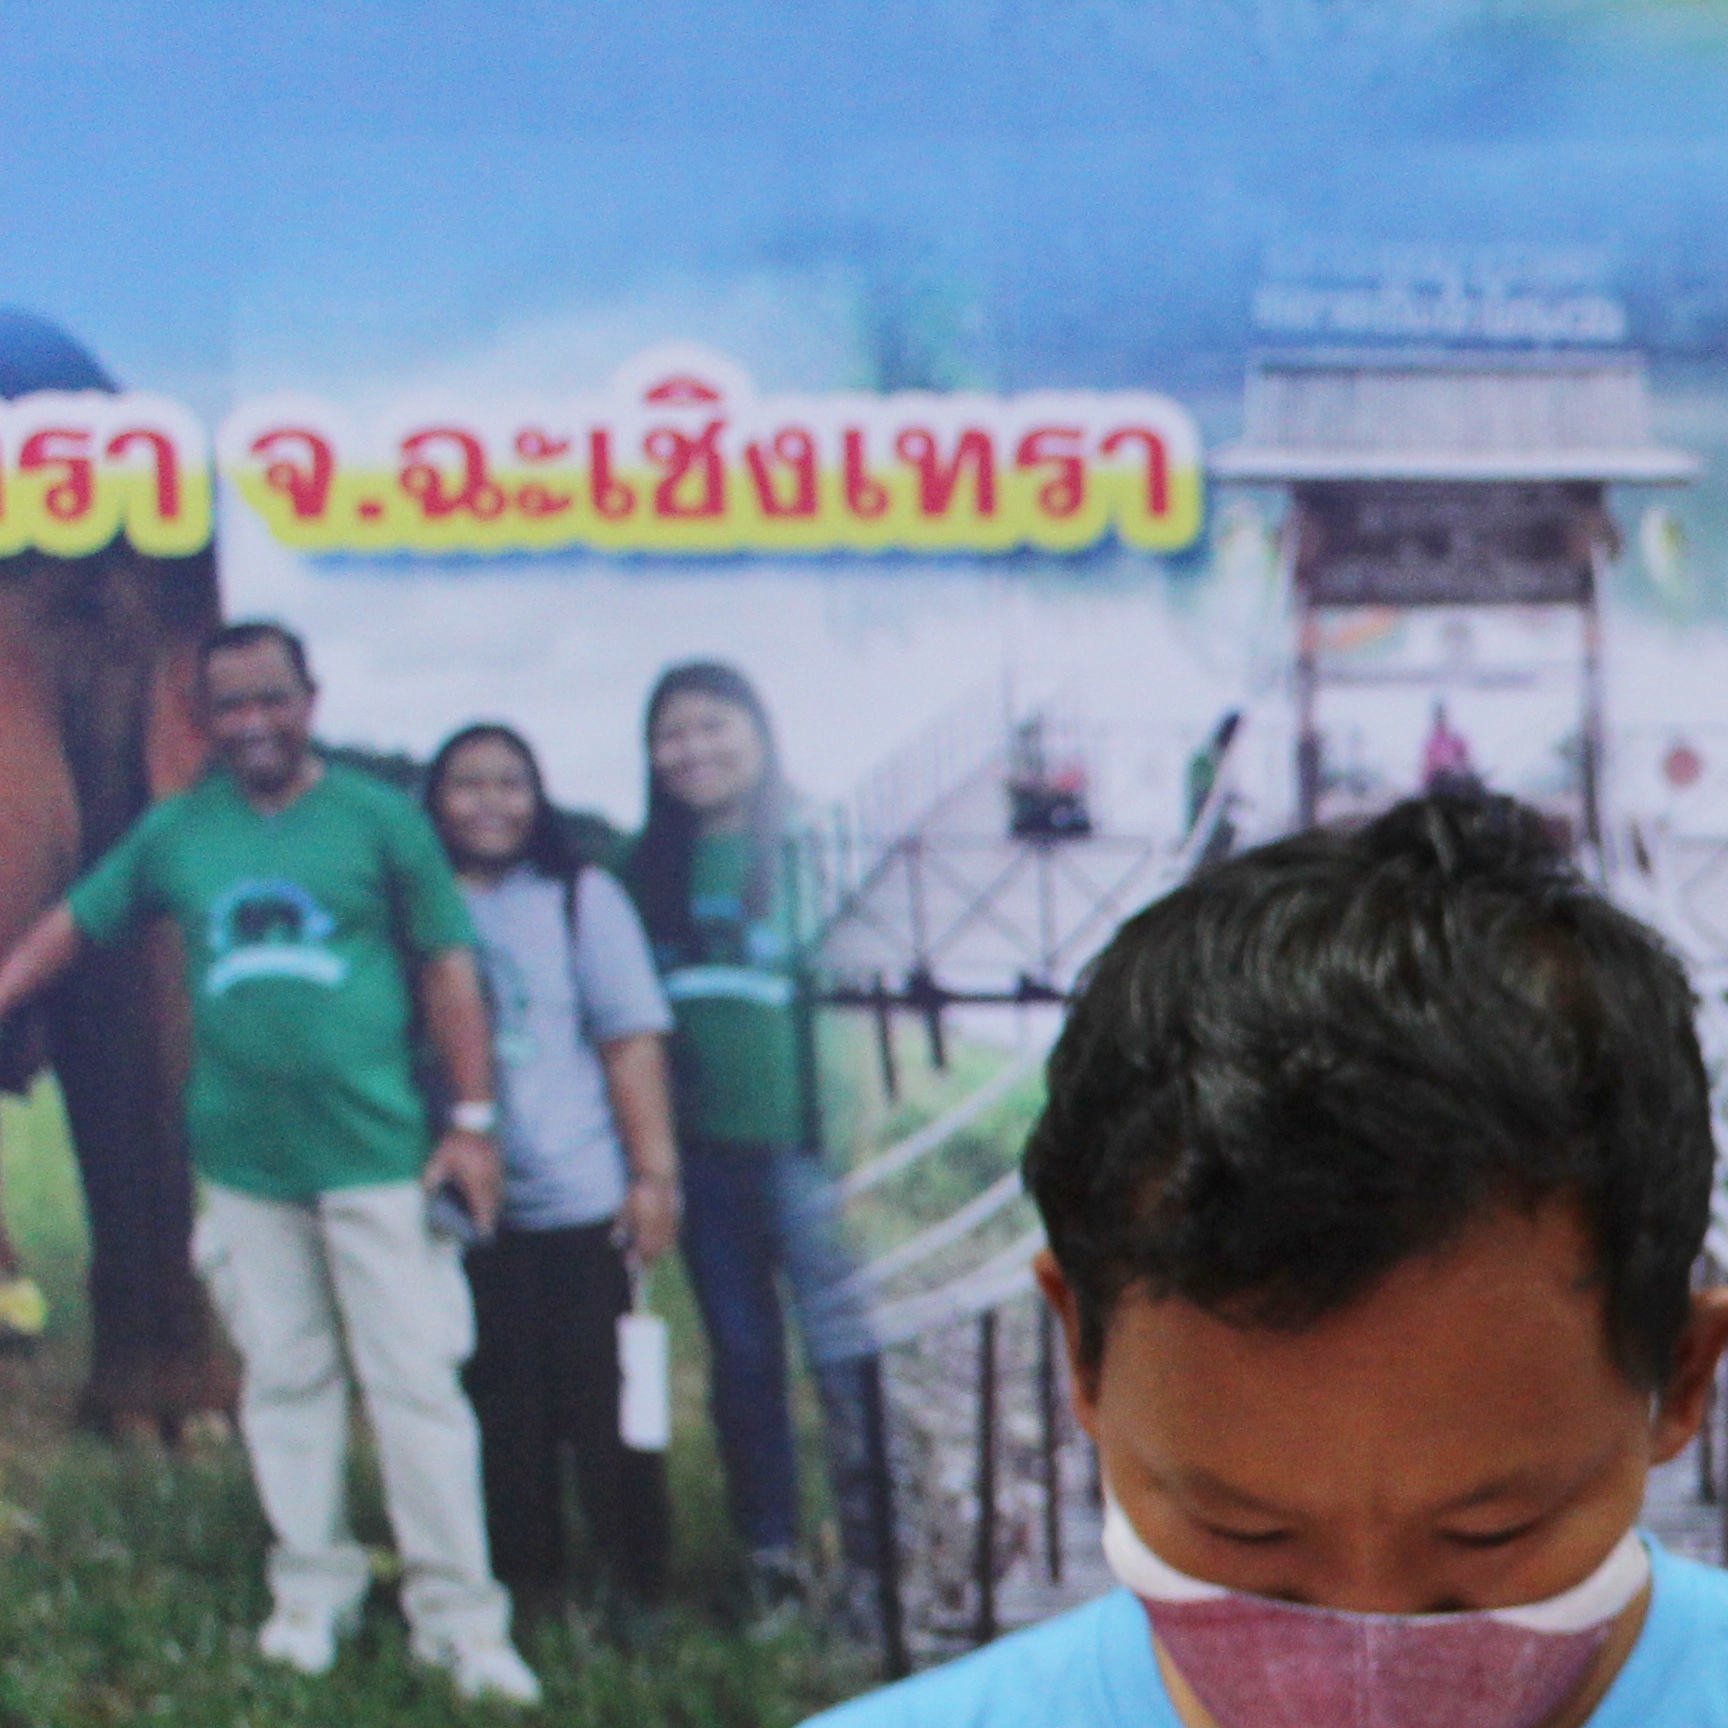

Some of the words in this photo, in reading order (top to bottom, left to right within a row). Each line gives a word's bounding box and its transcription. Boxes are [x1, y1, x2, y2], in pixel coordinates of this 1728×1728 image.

[249, 372, 1173, 521] จ.ฉะเชิงเทรา
